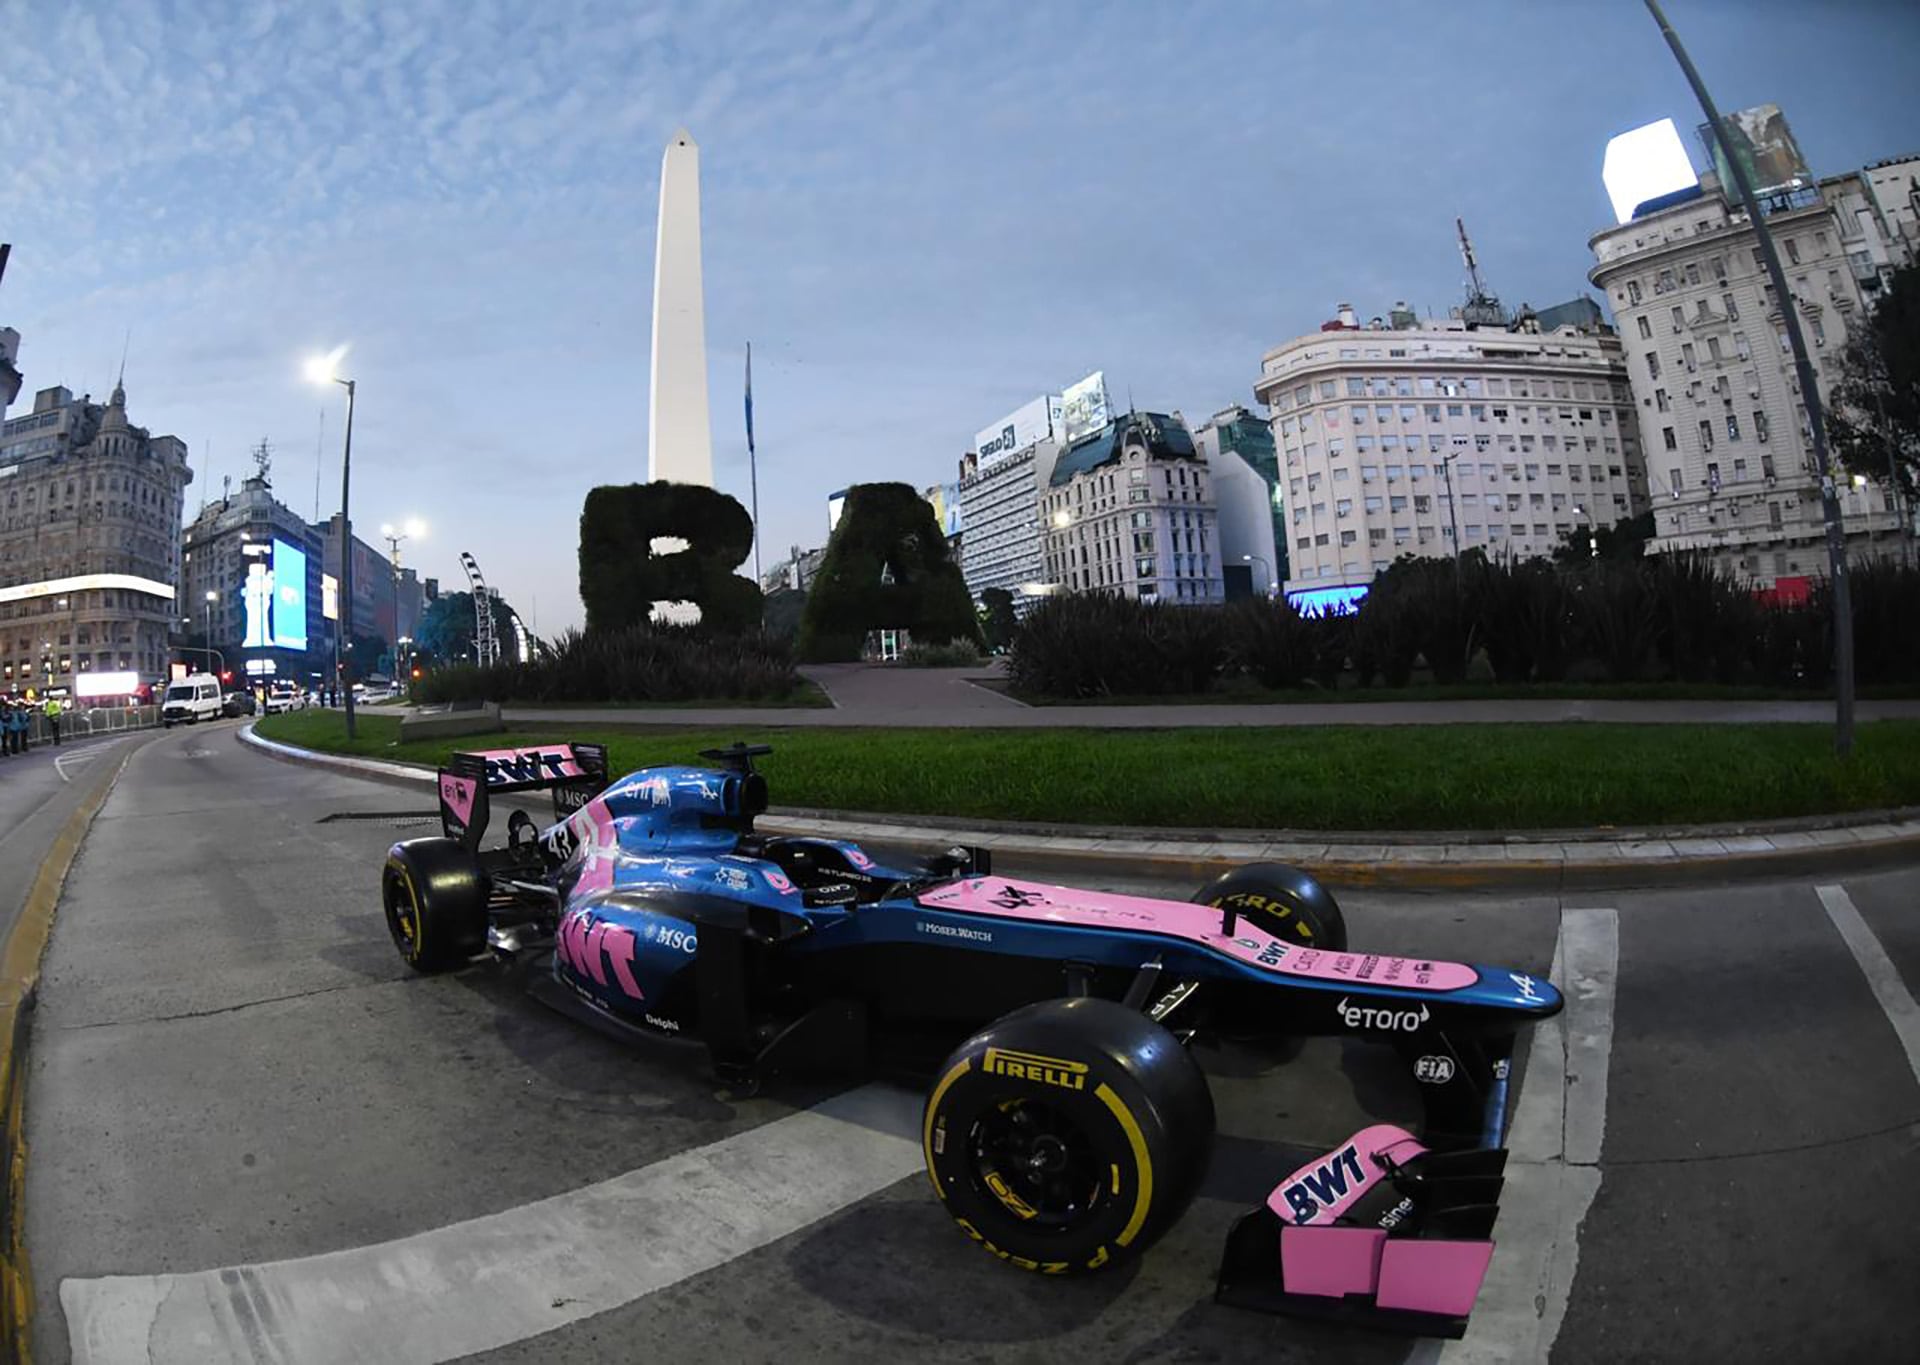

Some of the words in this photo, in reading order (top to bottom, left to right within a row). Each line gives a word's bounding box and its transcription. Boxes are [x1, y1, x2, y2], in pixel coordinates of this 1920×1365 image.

[485, 751, 565, 784] BWT
[549, 825, 572, 860] 43
[656, 926, 698, 953] MSC
[1257, 940, 1290, 966] BWT
[983, 1047, 1089, 1090] PIRELLI
[1415, 1059, 1452, 1080] FIA
[1283, 1144, 1366, 1226] BWT
